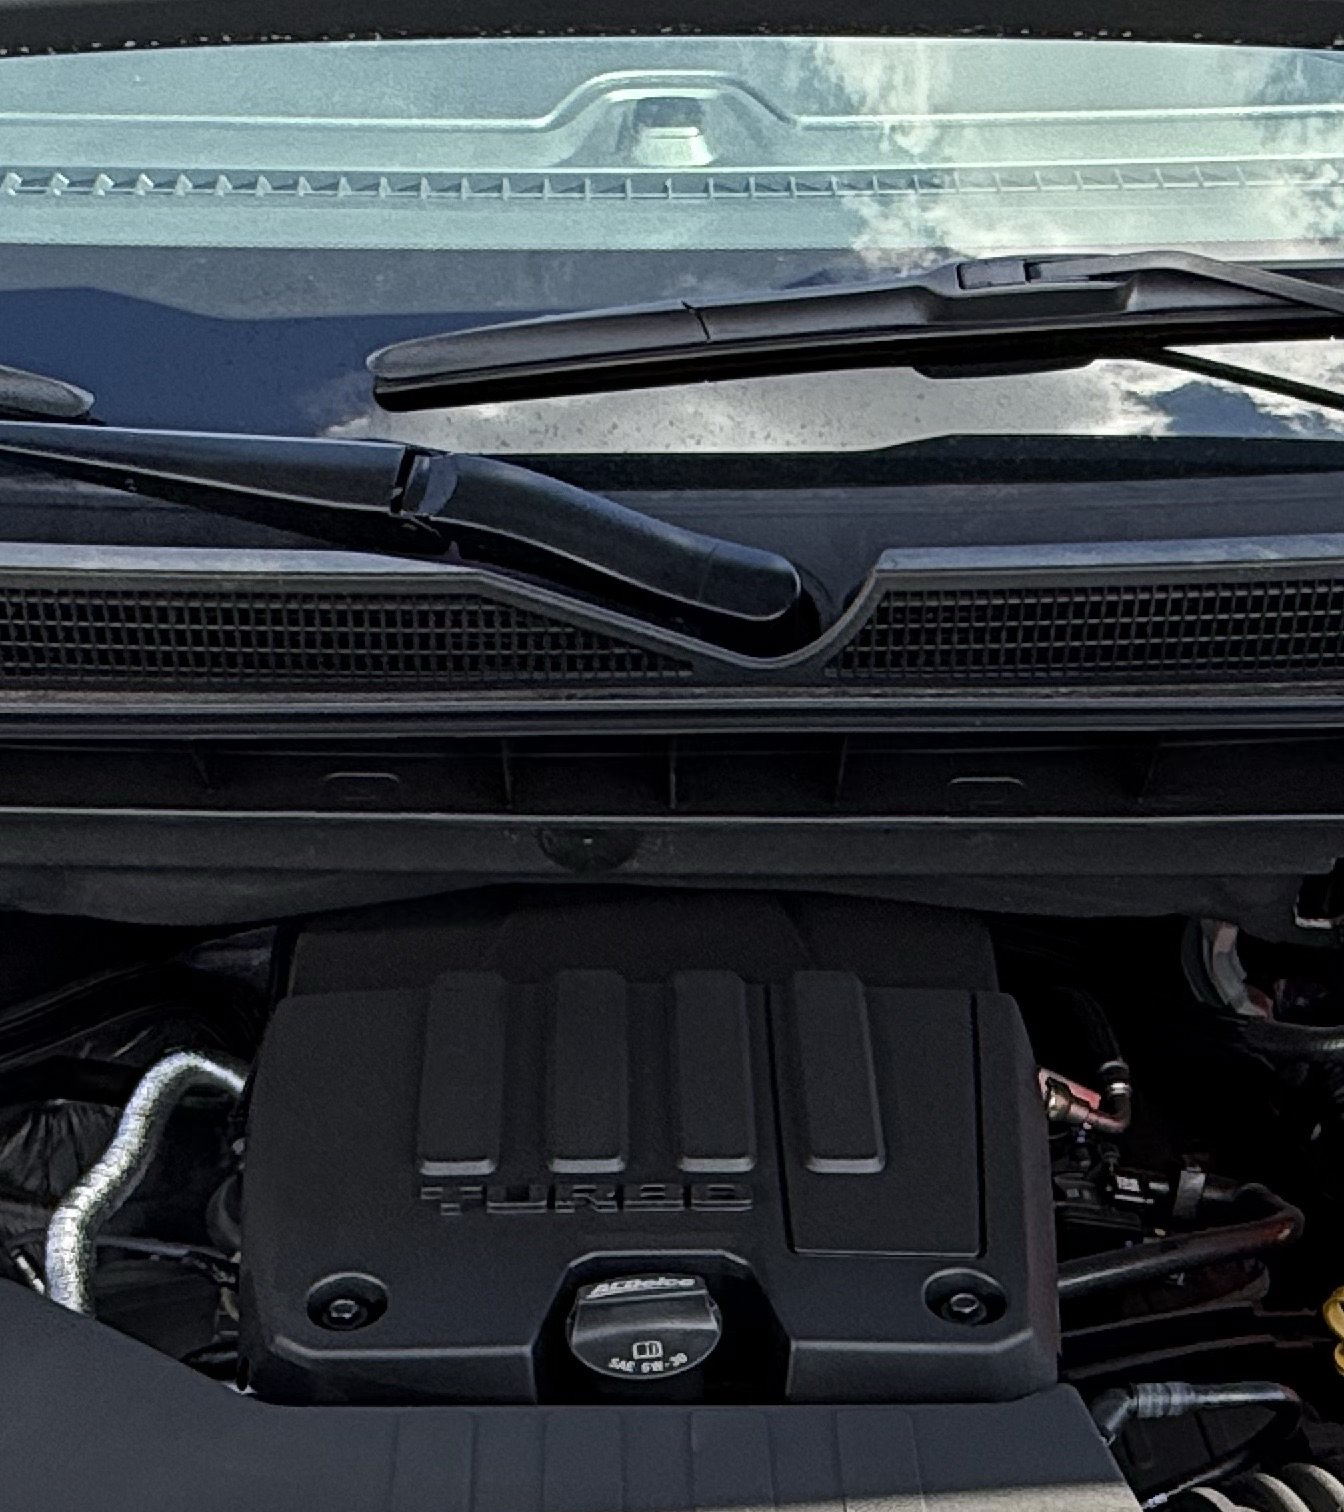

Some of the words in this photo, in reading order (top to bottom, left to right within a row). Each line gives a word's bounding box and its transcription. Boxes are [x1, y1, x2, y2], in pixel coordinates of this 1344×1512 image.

[420, 1183, 754, 1216] TURBO
[586, 1277, 696, 1300] ACDelco
[608, 1357, 636, 1373] SAE
